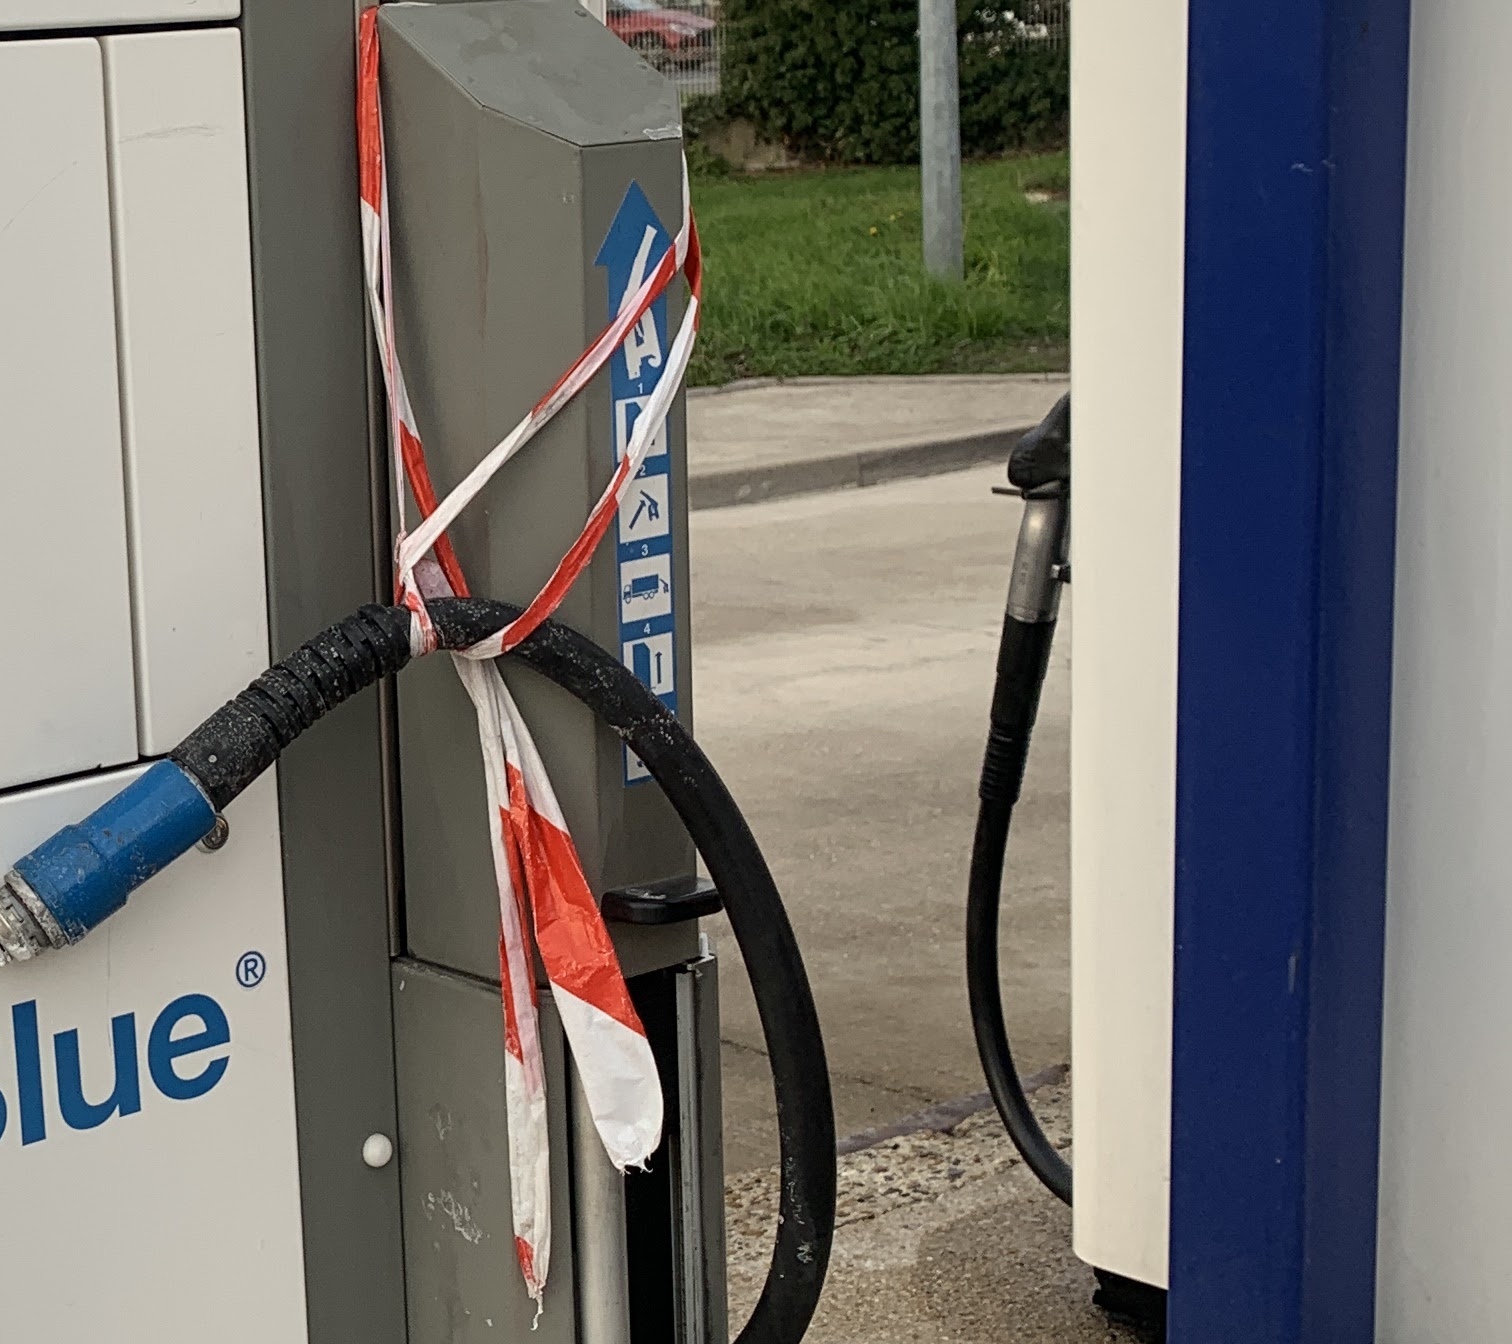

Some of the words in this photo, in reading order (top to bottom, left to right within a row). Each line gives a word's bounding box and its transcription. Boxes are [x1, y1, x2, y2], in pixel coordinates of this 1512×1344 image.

[637, 382, 644, 394] 1
[641, 544, 649, 556] 3
[643, 623, 651, 635] 4
